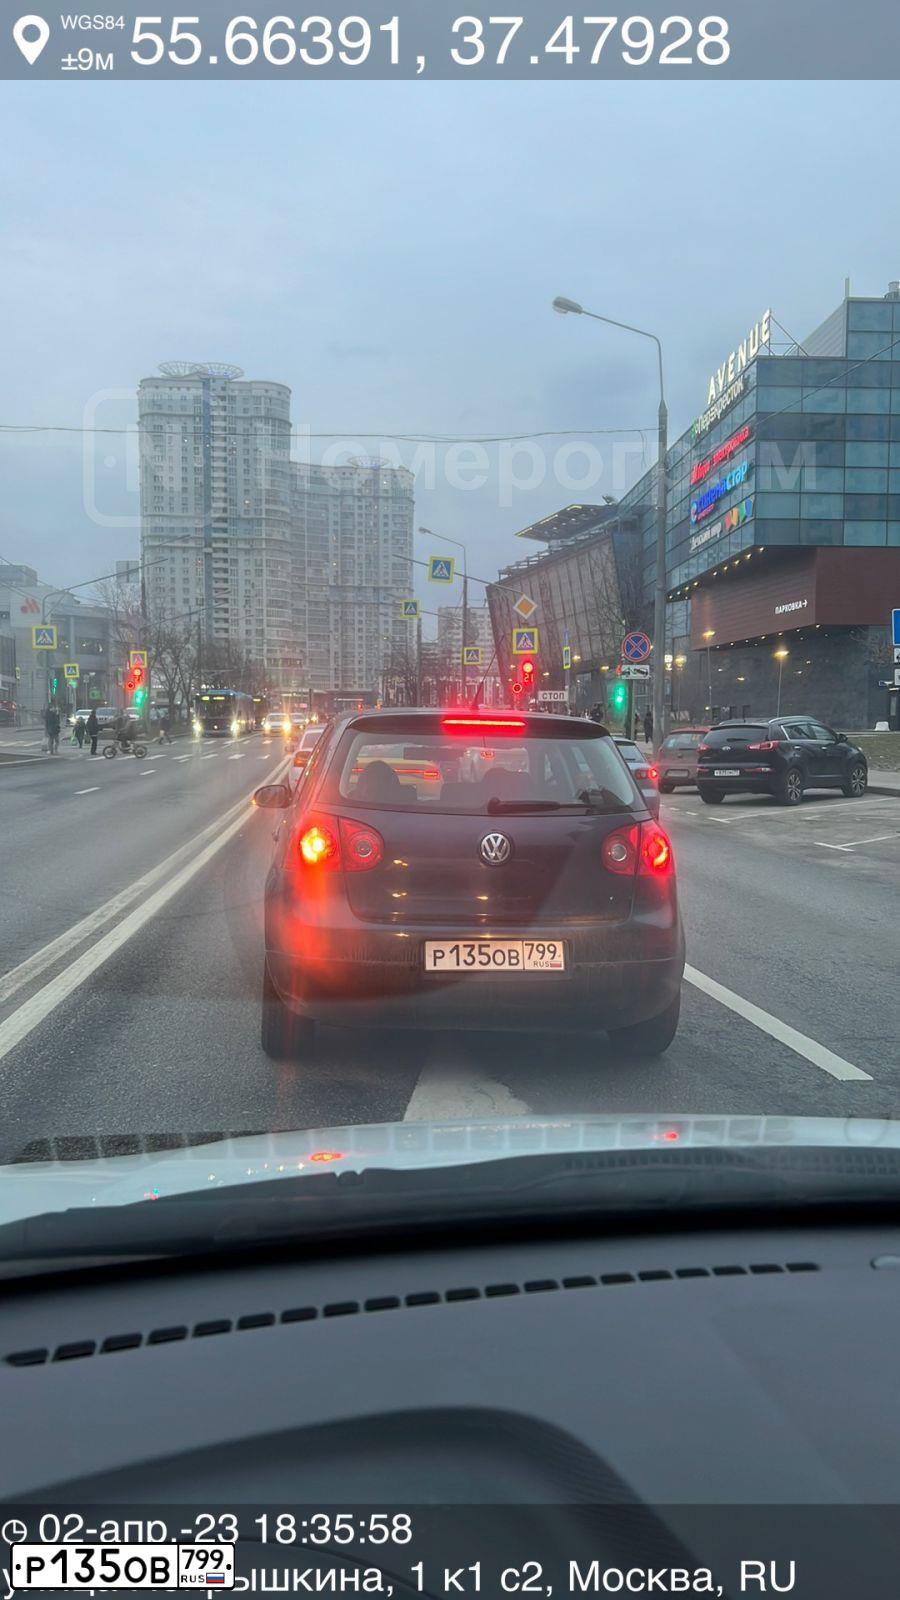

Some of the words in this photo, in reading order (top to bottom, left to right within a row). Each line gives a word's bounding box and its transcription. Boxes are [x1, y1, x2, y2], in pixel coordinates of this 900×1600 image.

[708, 308, 771, 405] AVENUE
[775, 600, 803, 614] ПАРКОВКА
[541, 692, 565, 700] СТОП
[525, 943, 557, 960] 799
[533, 960, 550, 968] RUS
